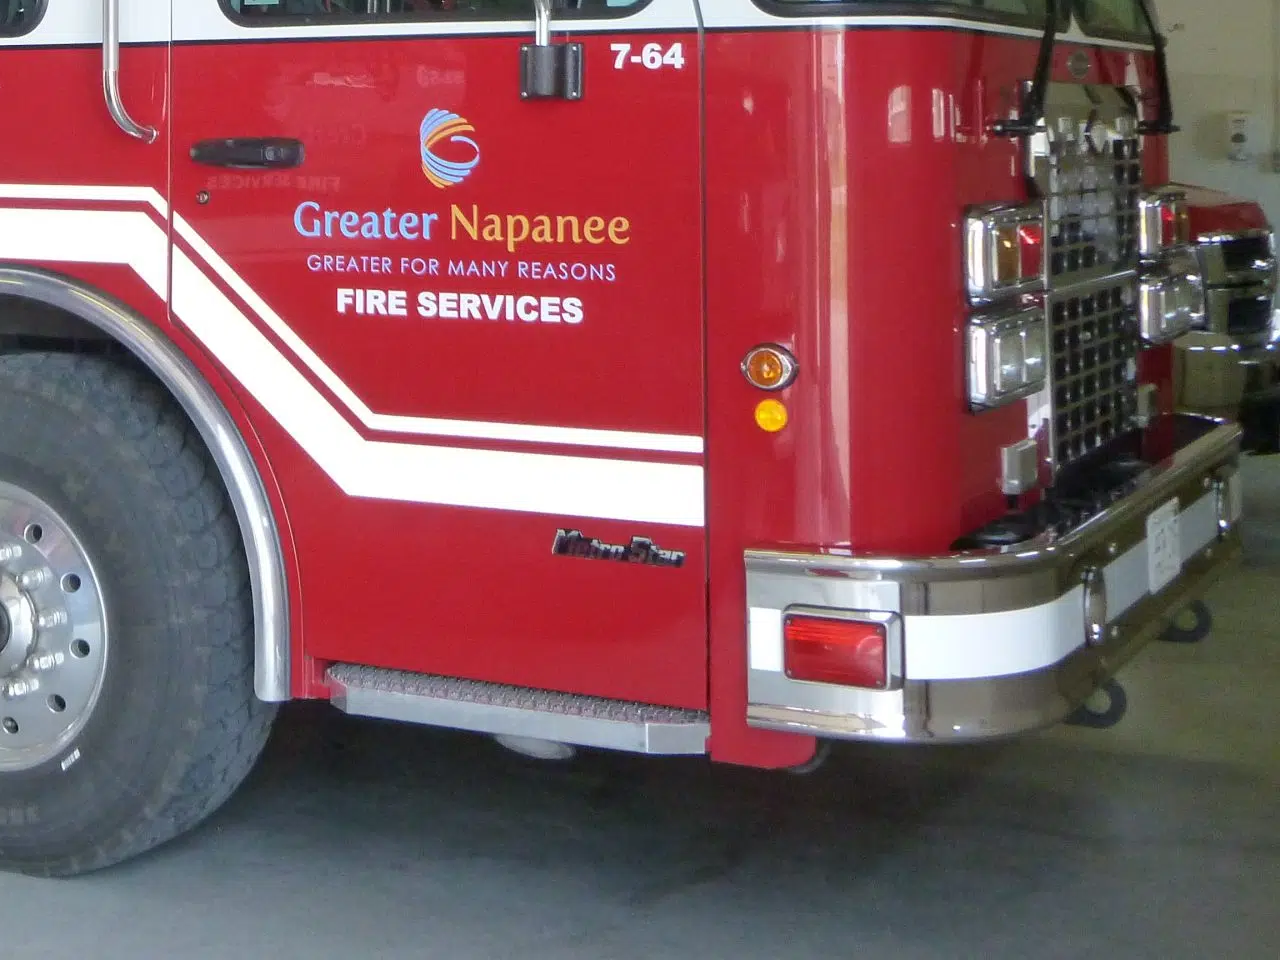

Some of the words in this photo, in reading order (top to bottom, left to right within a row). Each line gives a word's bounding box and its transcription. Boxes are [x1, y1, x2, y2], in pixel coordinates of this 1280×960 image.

[609, 42, 686, 70] 7-64
[293, 200, 439, 241] Greater
[450, 203, 630, 253] Napanee
[306, 253, 393, 274] GREATER
[400, 257, 440, 276] FOR
[447, 259, 509, 279] MANY
[517, 260, 616, 282] REASONS
[336, 287, 408, 317] FIRE
[416, 290, 584, 325] SERVICES
